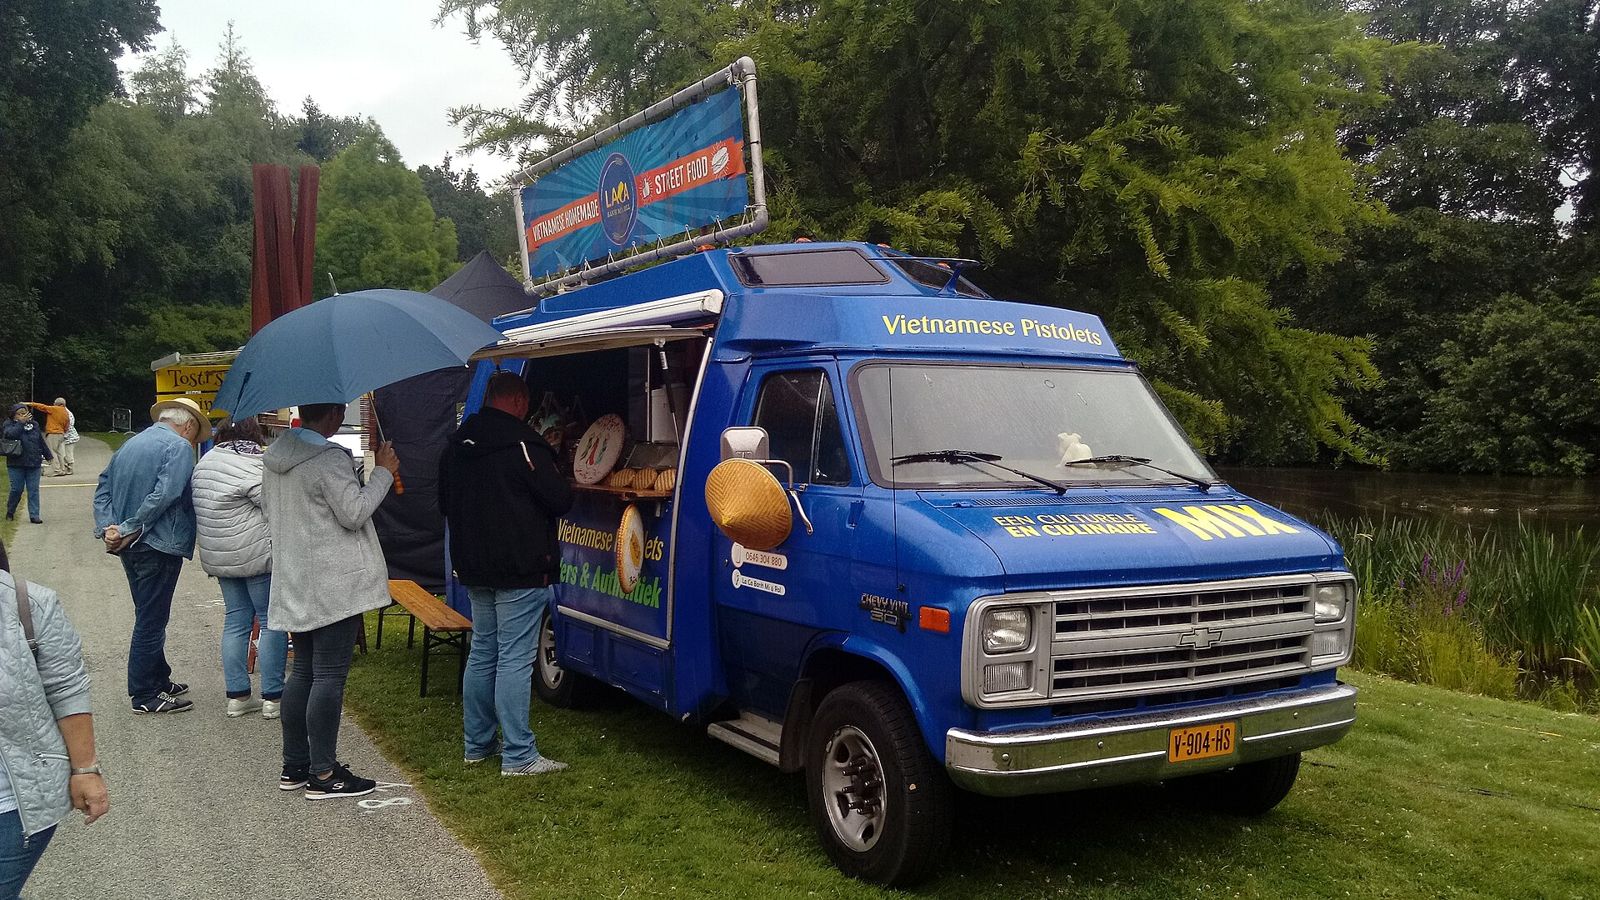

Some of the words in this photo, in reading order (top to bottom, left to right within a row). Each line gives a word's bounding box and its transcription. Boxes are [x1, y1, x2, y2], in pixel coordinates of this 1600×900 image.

[655, 164, 684, 195] STREET
[686, 155, 708, 183] FOOD
[532, 213, 566, 242] VIETNAMESE
[564, 199, 600, 228] HOMEMADE
[882, 314, 1016, 336] Vietnamese
[1020, 318, 1103, 346] Pistolets
[557, 518, 613, 552] Vietnamese
[992, 515, 1037, 528] EEN
[1036, 513, 1144, 526] CULTURELE
[1003, 525, 1041, 538] EN
[1040, 523, 1158, 536] CULINAIRE
[1152, 504, 1300, 541] MIX
[560, 557, 578, 585] ers
[580, 561, 591, 588] &
[870, 609, 898, 626] 30
[1174, 727, 1231, 758] V-904-HS
